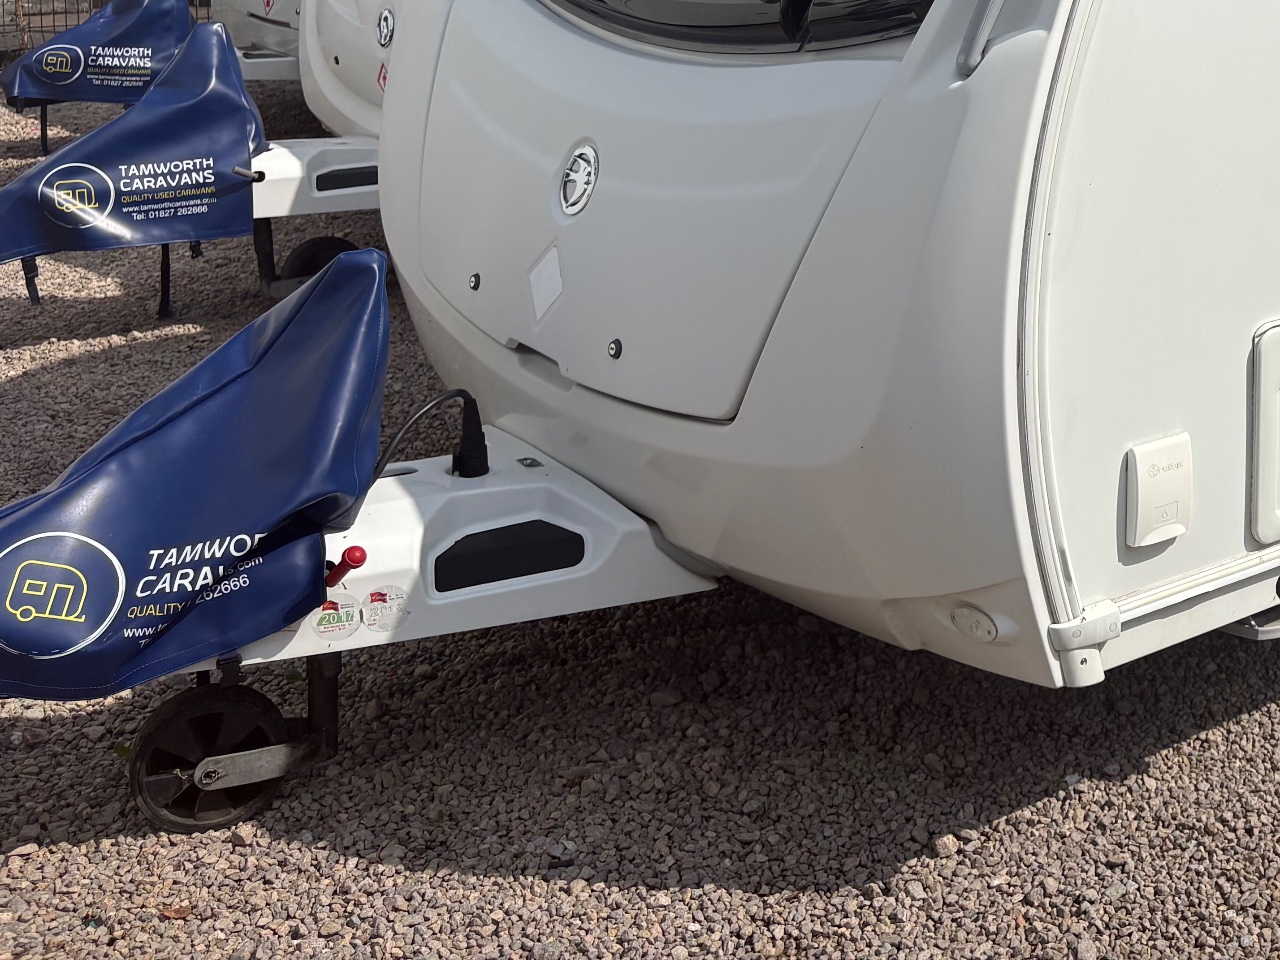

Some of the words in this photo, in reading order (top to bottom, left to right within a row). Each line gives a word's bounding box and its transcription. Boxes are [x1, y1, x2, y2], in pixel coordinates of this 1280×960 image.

[90, 45, 152, 57] TAMWORTH
[88, 55, 152, 68] CARAVANS
[119, 157, 214, 177] TAMWORTH
[120, 169, 215, 191] CARAVANS
[121, 192, 153, 203] QUALITY
[154, 190, 175, 200] USED
[176, 186, 216, 197] CARAVANS
[122, 197, 217, 213] www.tamworthcaravans.com
[132, 212, 147, 220] Tel:
[148, 208, 174, 219] 01827
[177, 205, 208, 216] 262666
[127, 601, 186, 619] QUALITY
[321, 610, 355, 625] 2017
